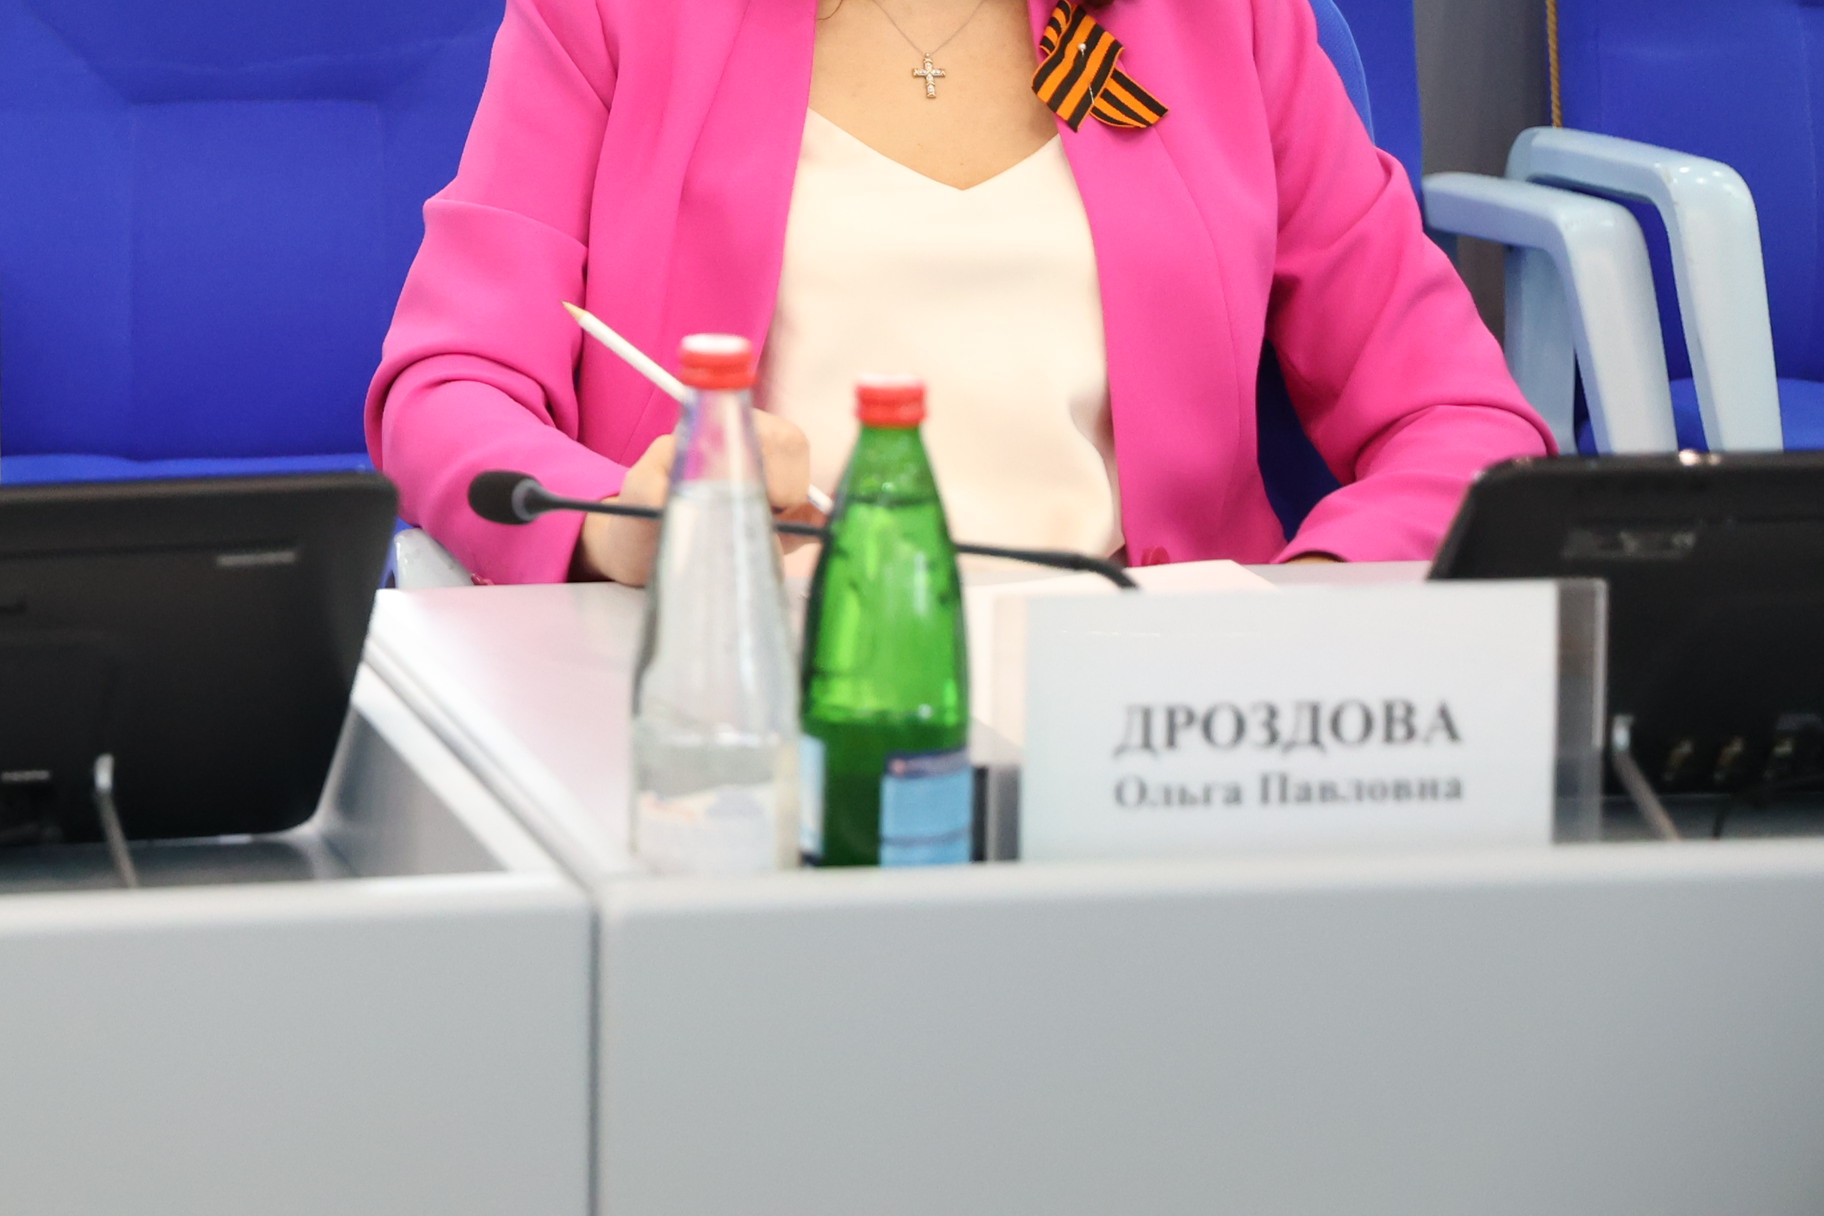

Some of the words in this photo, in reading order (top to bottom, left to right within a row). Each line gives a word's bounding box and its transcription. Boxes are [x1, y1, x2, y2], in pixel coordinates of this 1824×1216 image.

[1112, 698, 1464, 757] ДРОЗДОВА
[1113, 776, 1244, 810] Ольга
[1259, 772, 1464, 805] Павловна
